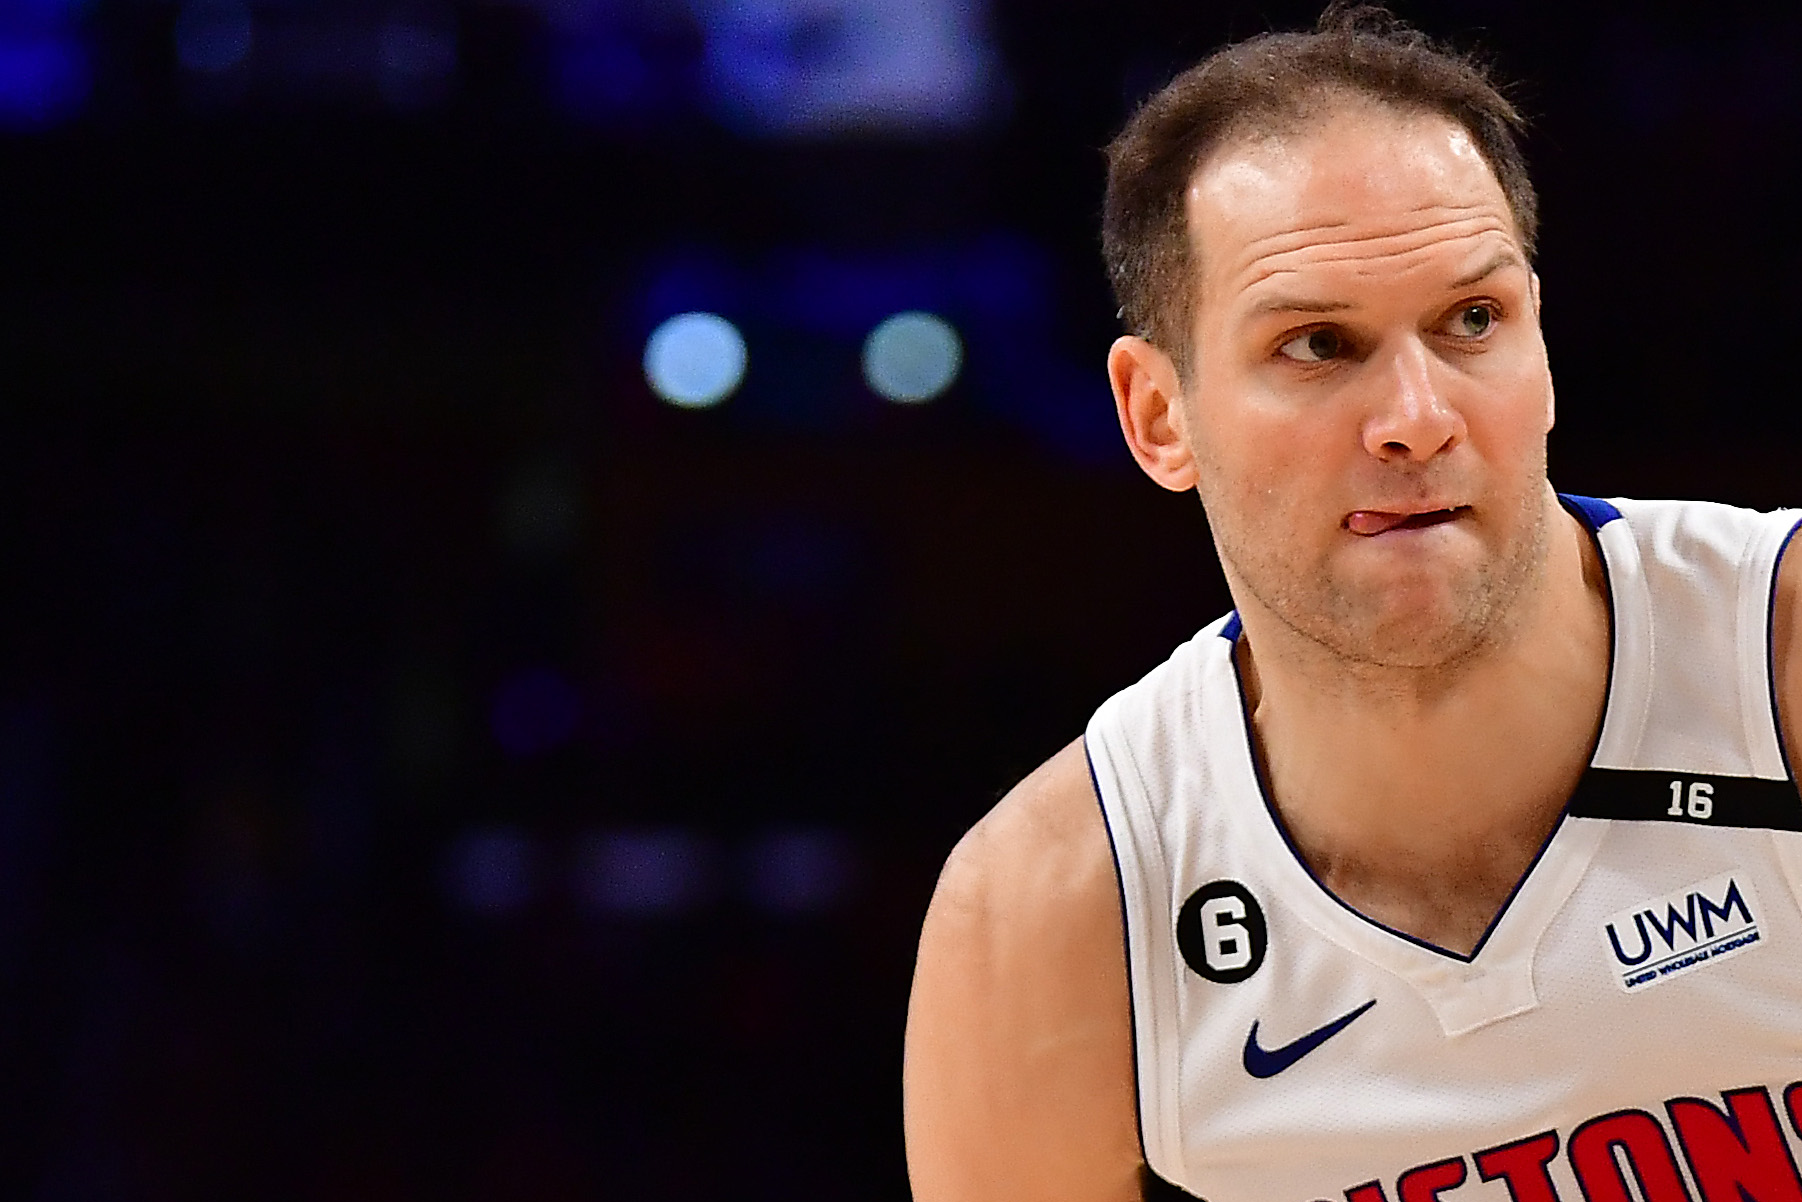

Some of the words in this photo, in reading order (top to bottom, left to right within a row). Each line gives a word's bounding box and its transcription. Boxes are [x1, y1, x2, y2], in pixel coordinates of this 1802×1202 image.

[1667, 781, 1714, 819] 16
[1200, 896, 1252, 971] 6
[1605, 877, 1753, 966] UWM
